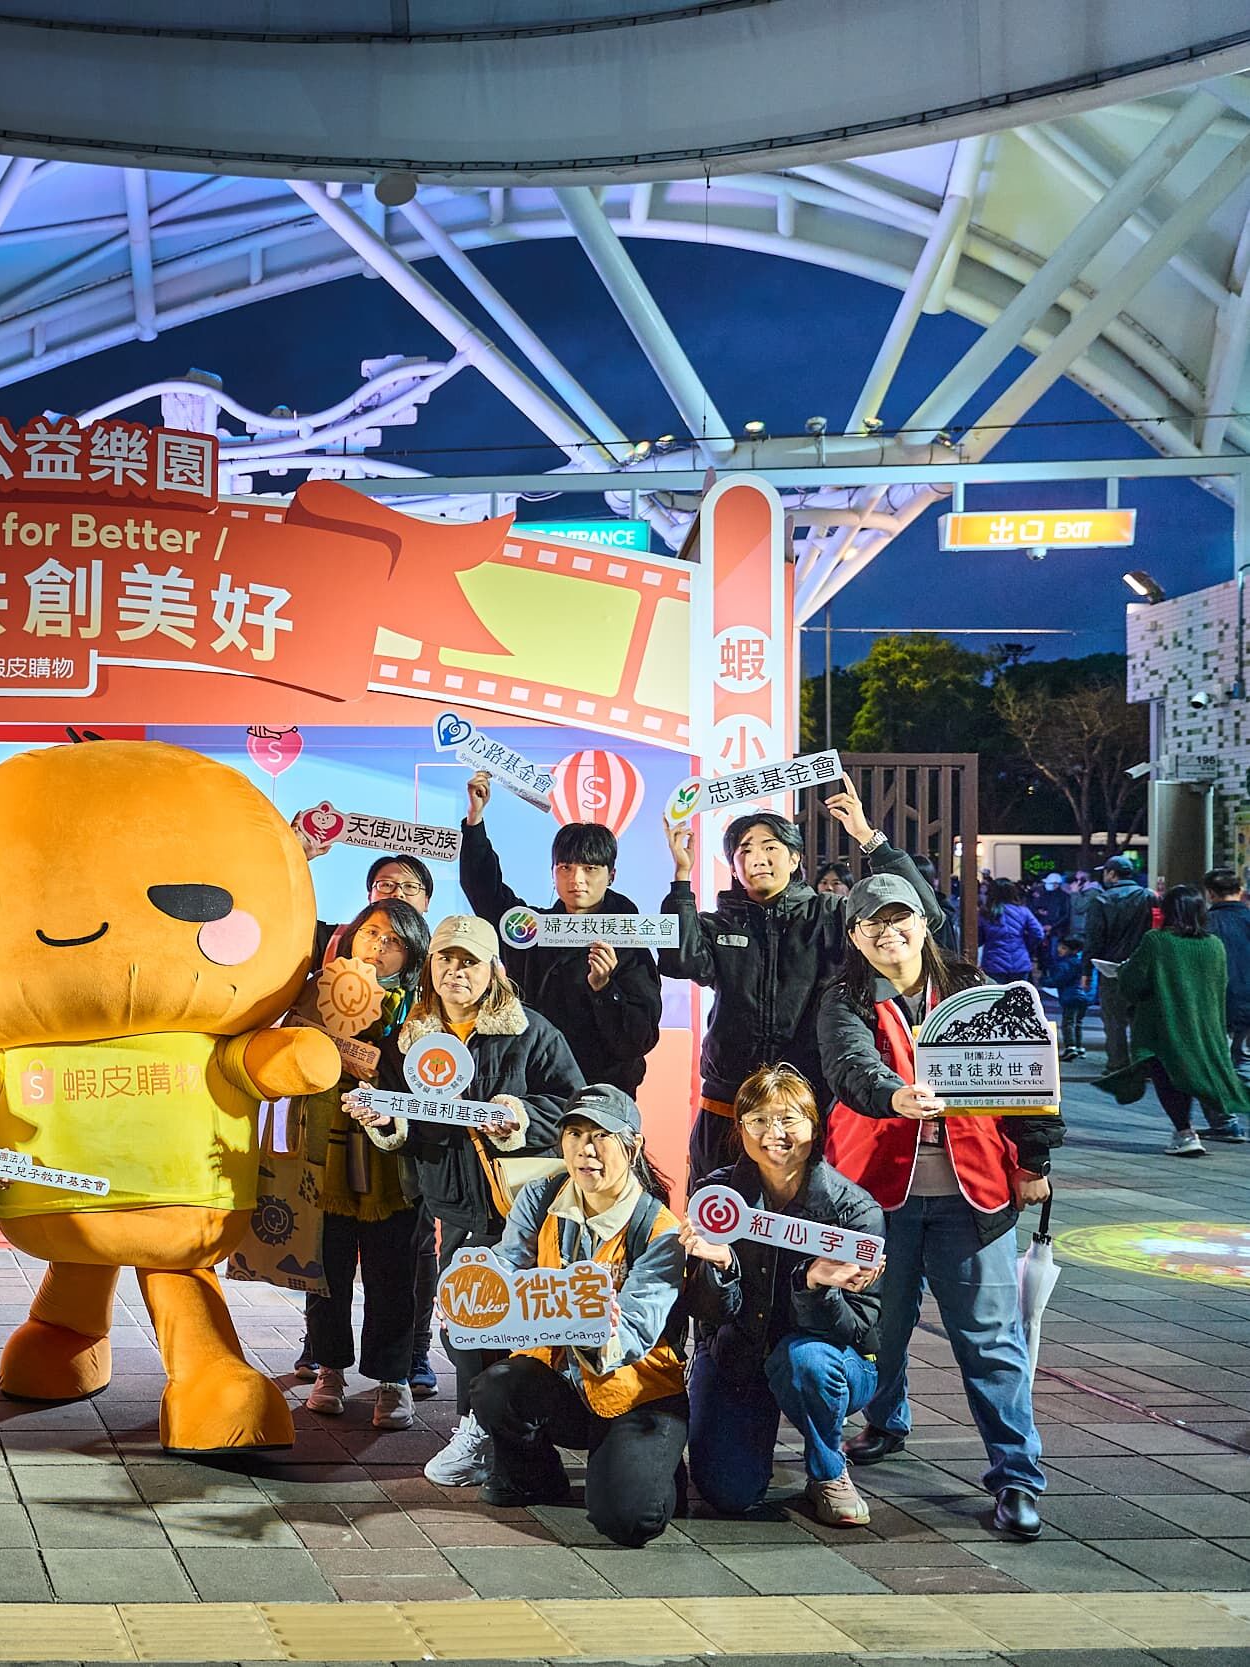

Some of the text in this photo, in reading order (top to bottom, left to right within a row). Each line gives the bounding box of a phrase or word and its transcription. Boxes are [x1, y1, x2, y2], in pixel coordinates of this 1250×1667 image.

[2, 512, 60, 548] for
[71, 516, 200, 555] Better
[989, 517, 1093, 543] 出口 EXIT
[469, 736, 554, 793] 心路基金會
[708, 756, 835, 804] 忠義基金會
[345, 836, 455, 860] ANGEL HEART FAMILY
[347, 816, 458, 850] 天使心家族
[544, 917, 675, 935] 婦女救援基金會
[544, 938, 565, 946] Taipei
[927, 1062, 1044, 1077] 基督徒救世會
[964, 1051, 1005, 1061] 財團法人
[927, 1078, 1045, 1087] Christian Salvation Service
[357, 1091, 506, 1127] 第一社會福利基金會
[749, 1213, 879, 1263] 紅心字會
[445, 1282, 510, 1317] Waker
[514, 1265, 610, 1321] 微客
[455, 1336, 475, 1344] One
[539, 1332, 561, 1340] One
[565, 1330, 606, 1344] Change
